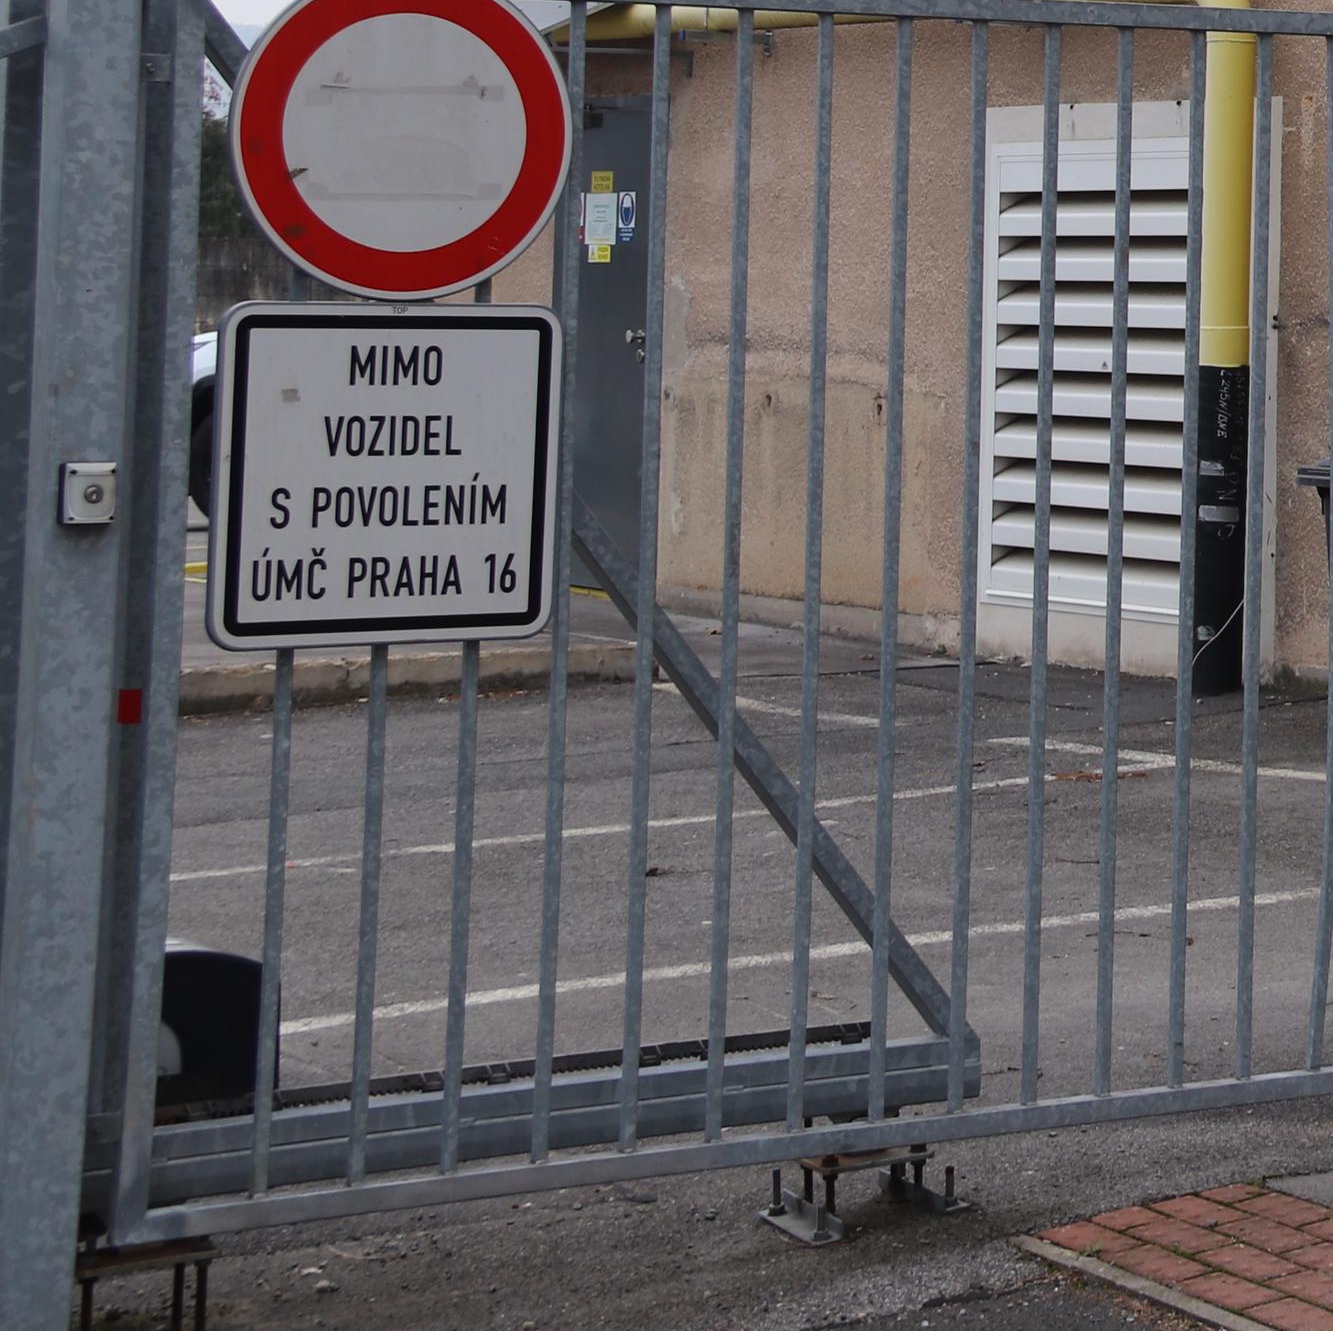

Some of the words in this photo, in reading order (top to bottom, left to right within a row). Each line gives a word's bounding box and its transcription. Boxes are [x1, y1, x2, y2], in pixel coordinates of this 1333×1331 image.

[349, 345, 443, 387] MIMO
[323, 415, 462, 457] VOZIDEL
[269, 487, 291, 530] S
[311, 472, 507, 529] POVOLENÍM
[251, 547, 328, 602] ÚMČ
[347, 554, 463, 599] PRAHA
[484, 552, 517, 594] 16
